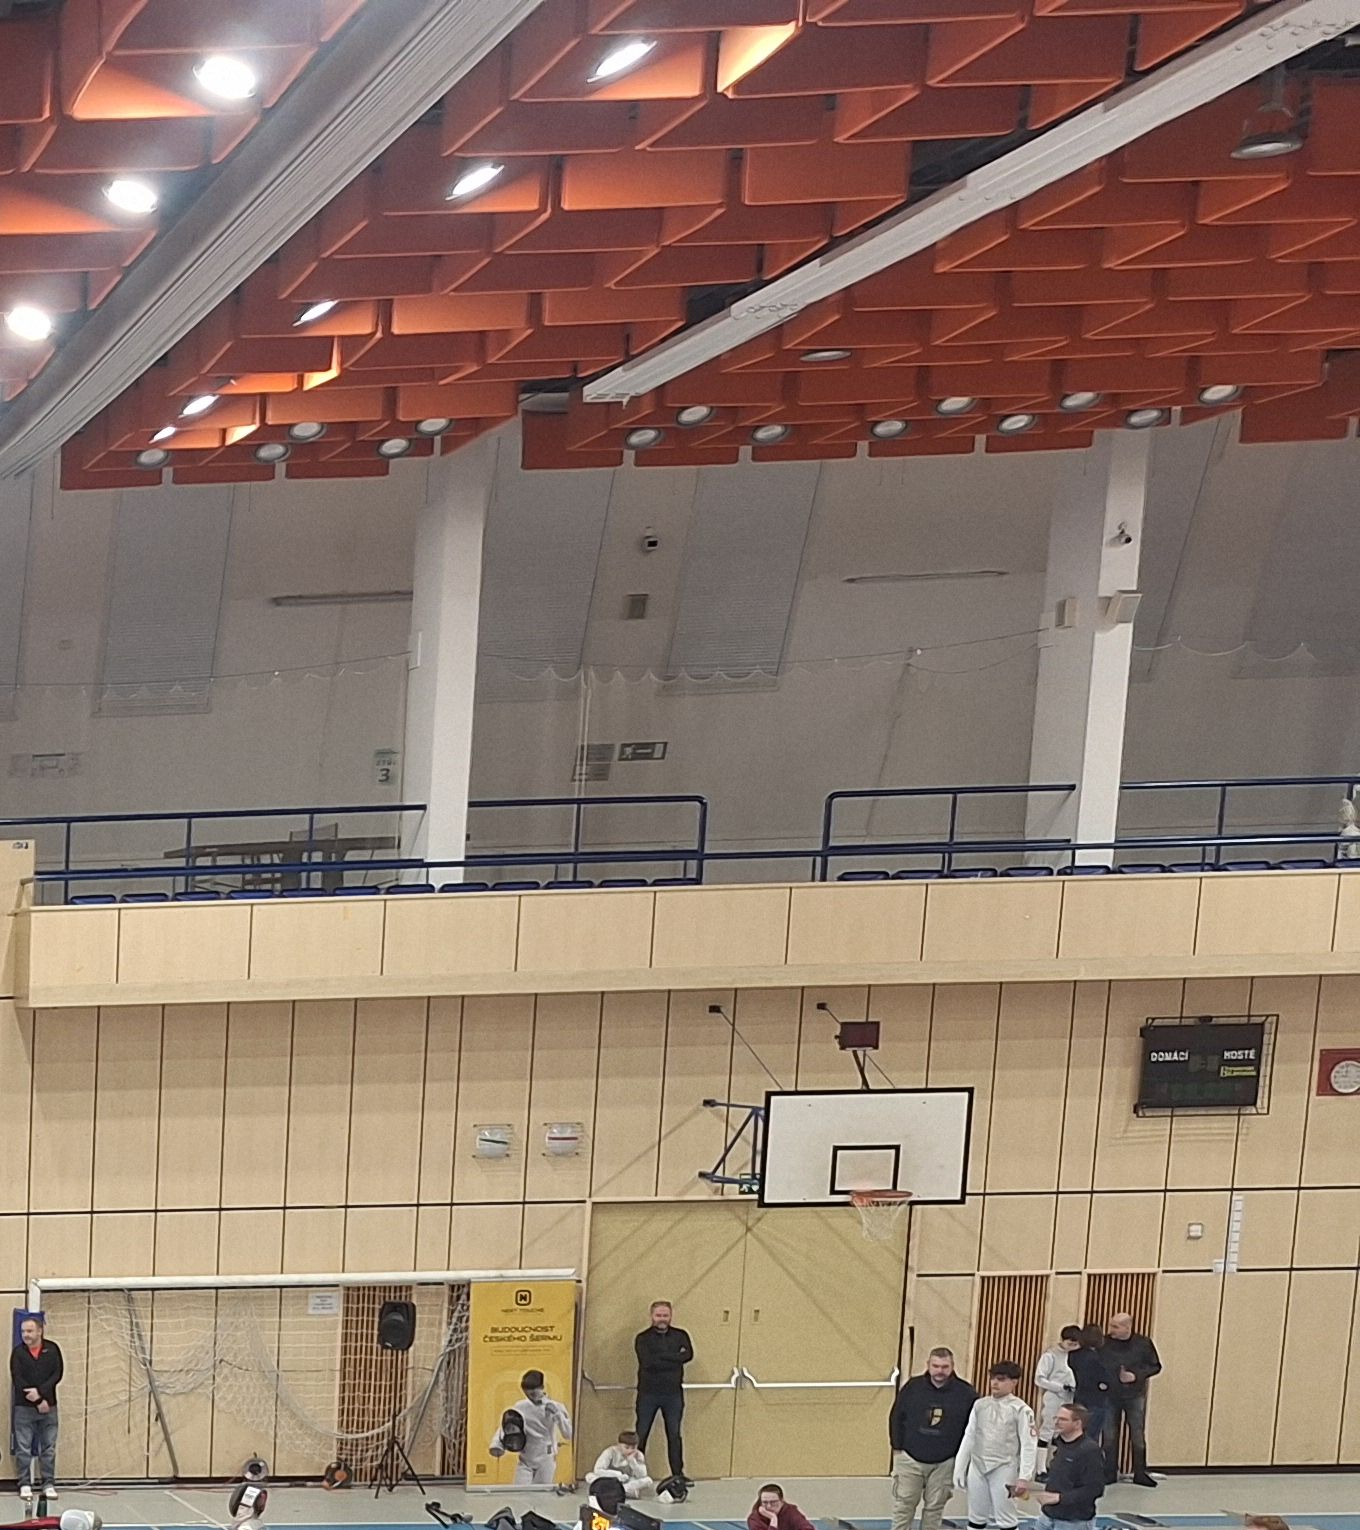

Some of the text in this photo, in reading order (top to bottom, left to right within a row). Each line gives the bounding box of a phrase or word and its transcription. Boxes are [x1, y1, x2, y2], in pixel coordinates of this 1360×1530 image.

[1150, 1049, 1189, 1062] DOMÁCÍ
[490, 1325, 556, 1334] BUDOUCNOST
[482, 1335, 528, 1343] ČESKÉHO
